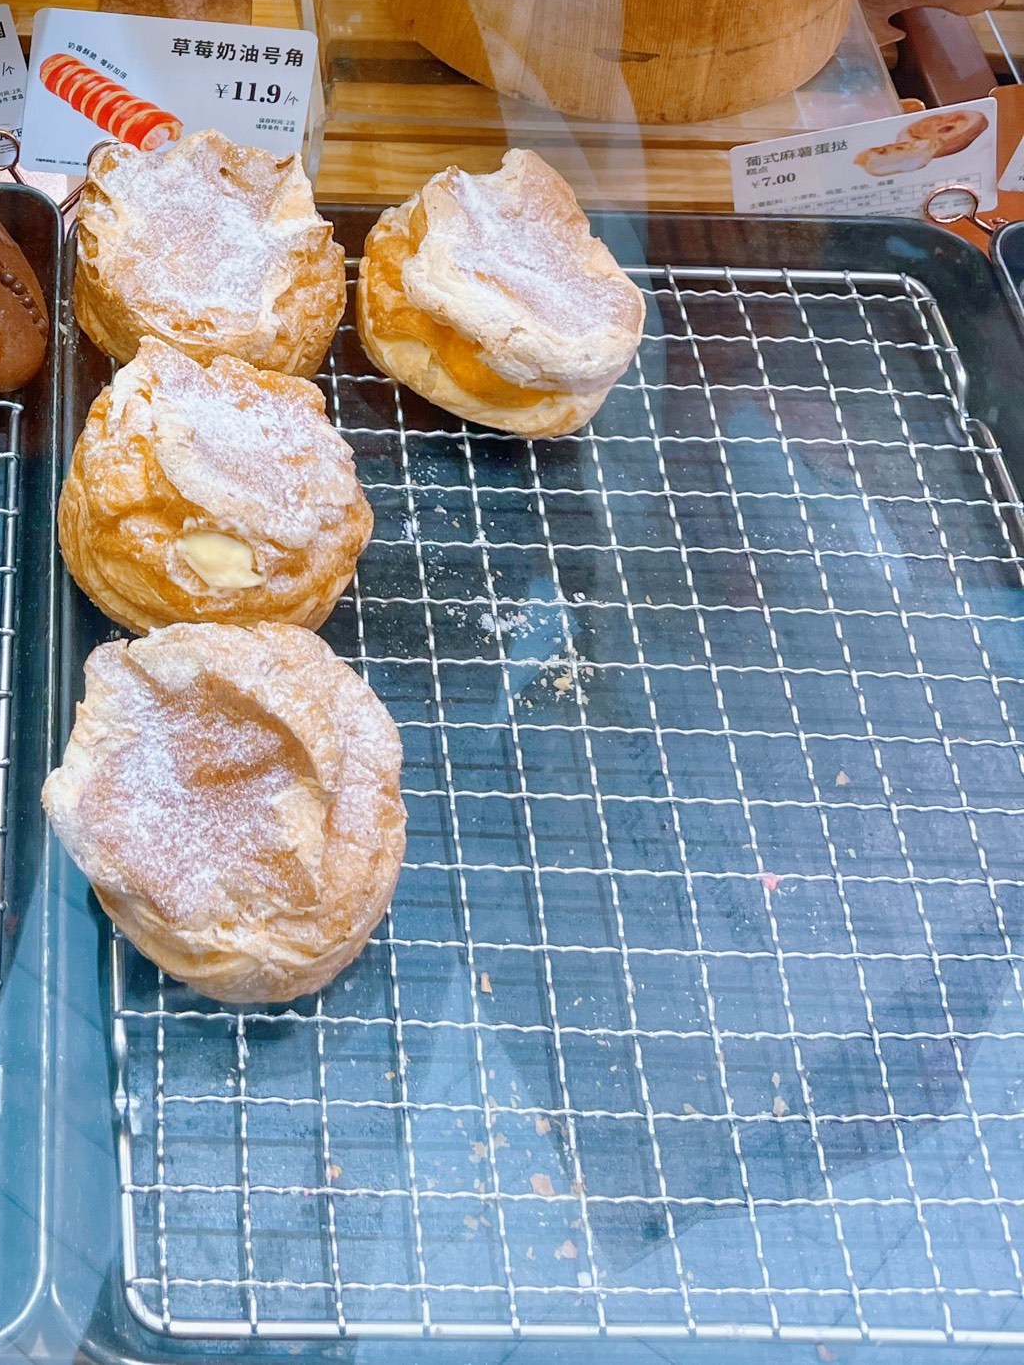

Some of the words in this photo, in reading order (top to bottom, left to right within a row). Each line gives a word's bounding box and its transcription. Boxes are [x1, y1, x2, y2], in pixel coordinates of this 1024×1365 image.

[170, 36, 304, 68] 草莓奶油号角
[744, 138, 849, 168] 葡式麻薯蛋挞
[750, 172, 797, 189] ¥7.00
